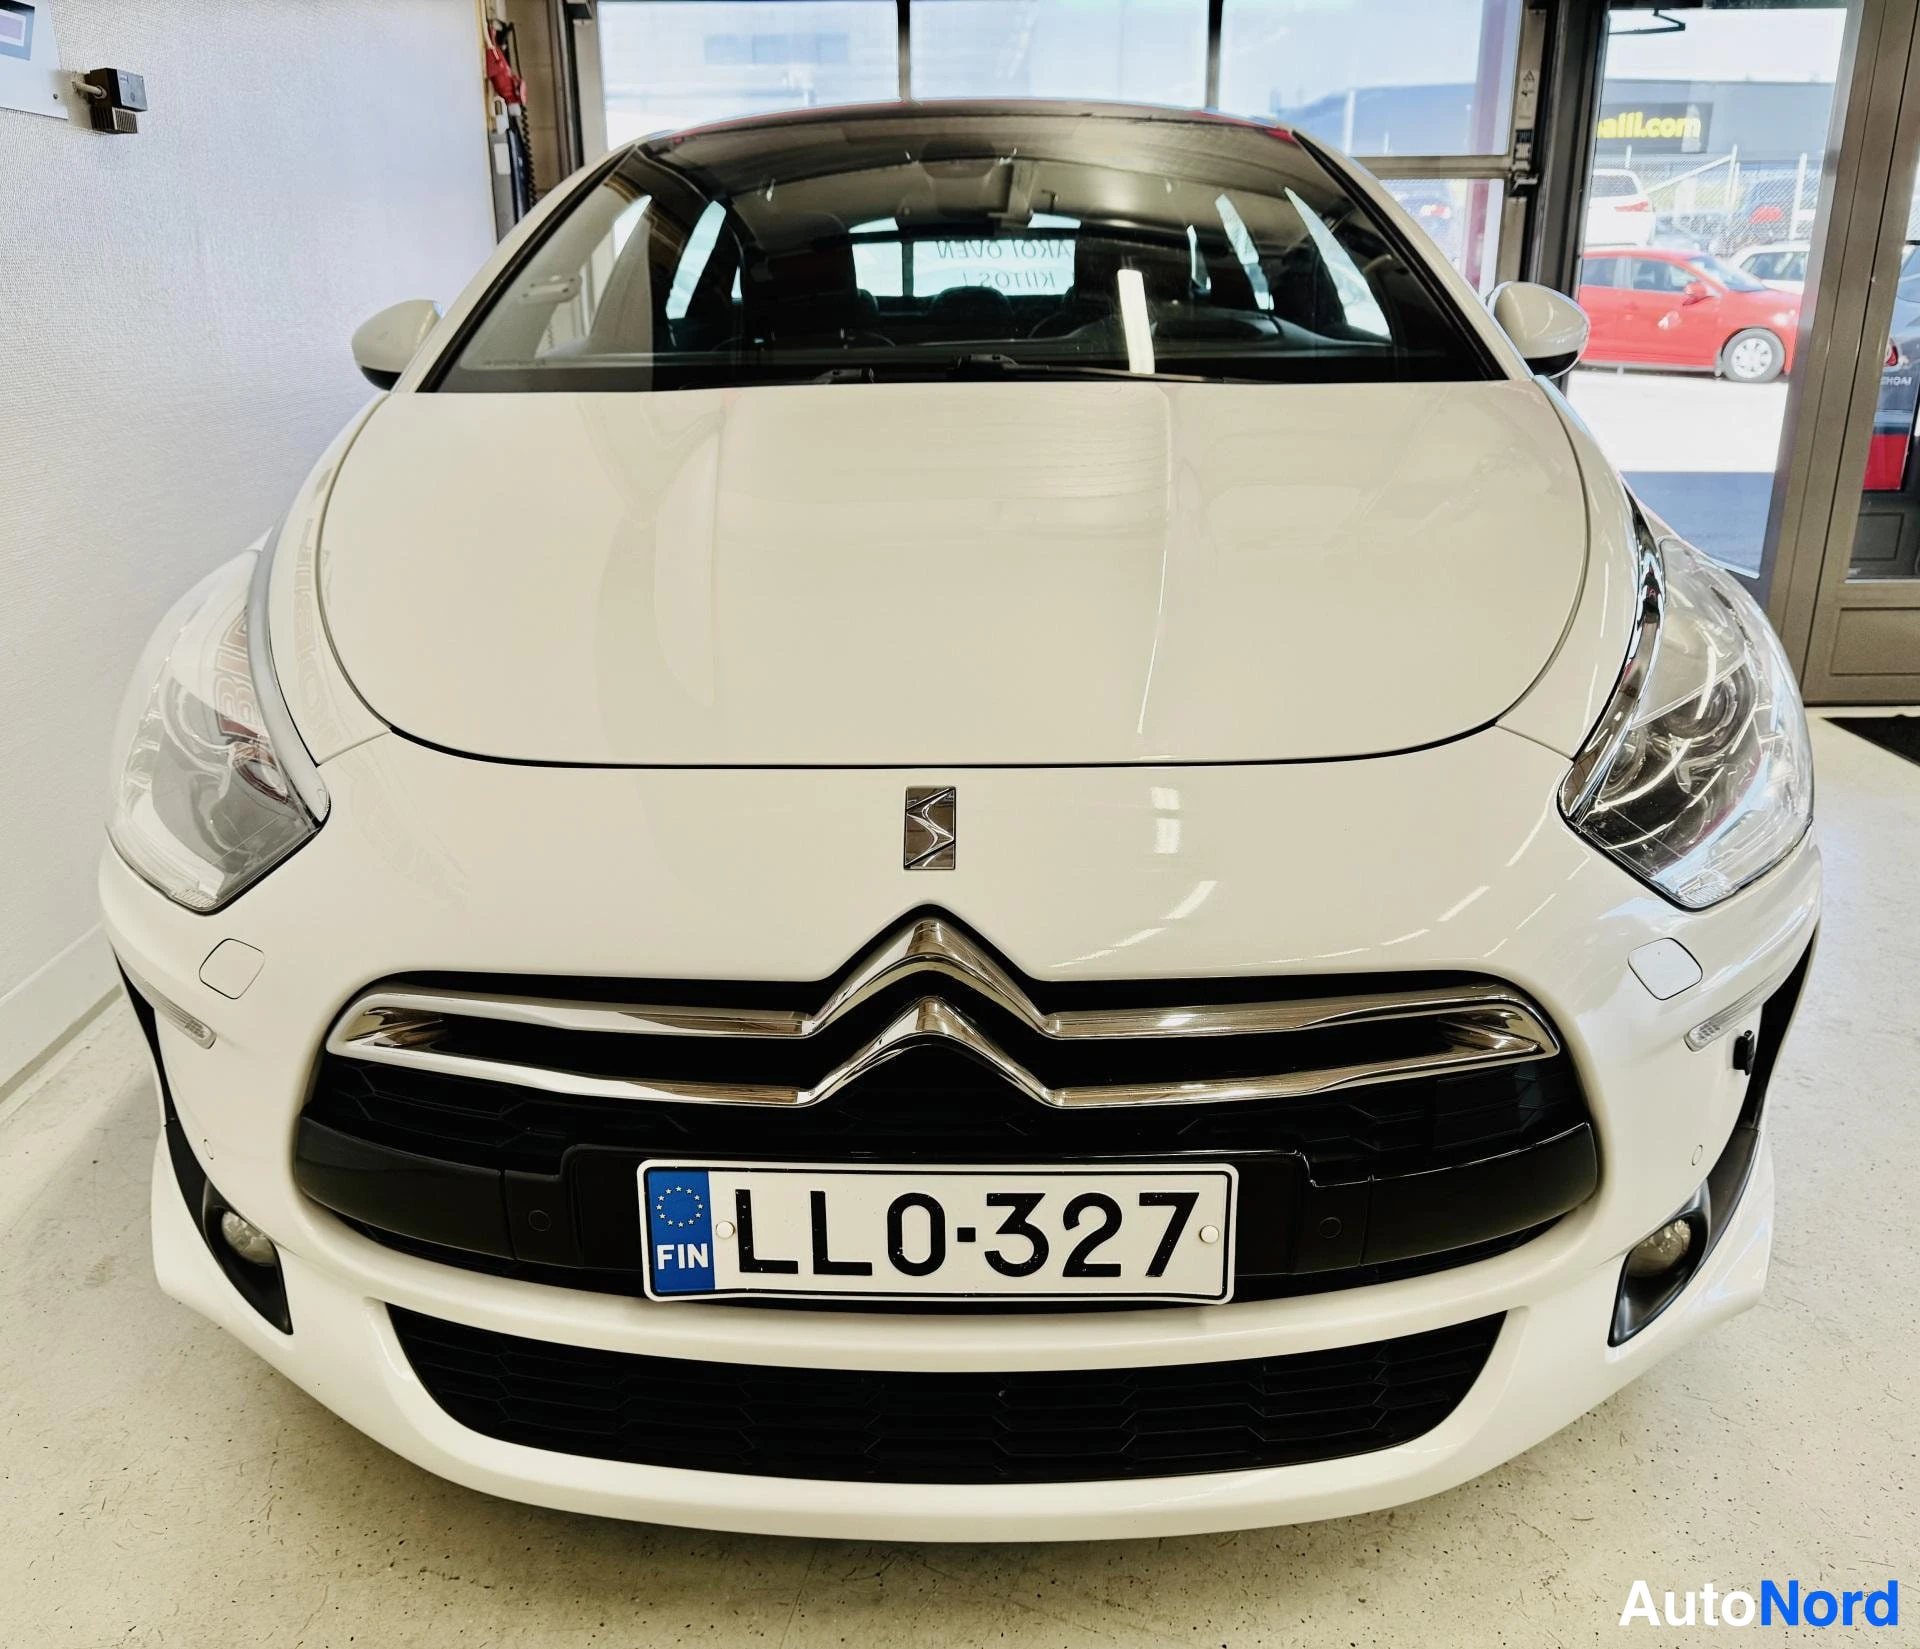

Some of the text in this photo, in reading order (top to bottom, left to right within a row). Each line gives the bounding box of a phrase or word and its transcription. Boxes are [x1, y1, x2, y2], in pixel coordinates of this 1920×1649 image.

[1597, 111, 1702, 139] alli.com
[735, 1188, 1200, 1278] LLO-327
[656, 1242, 709, 1271] FIN
